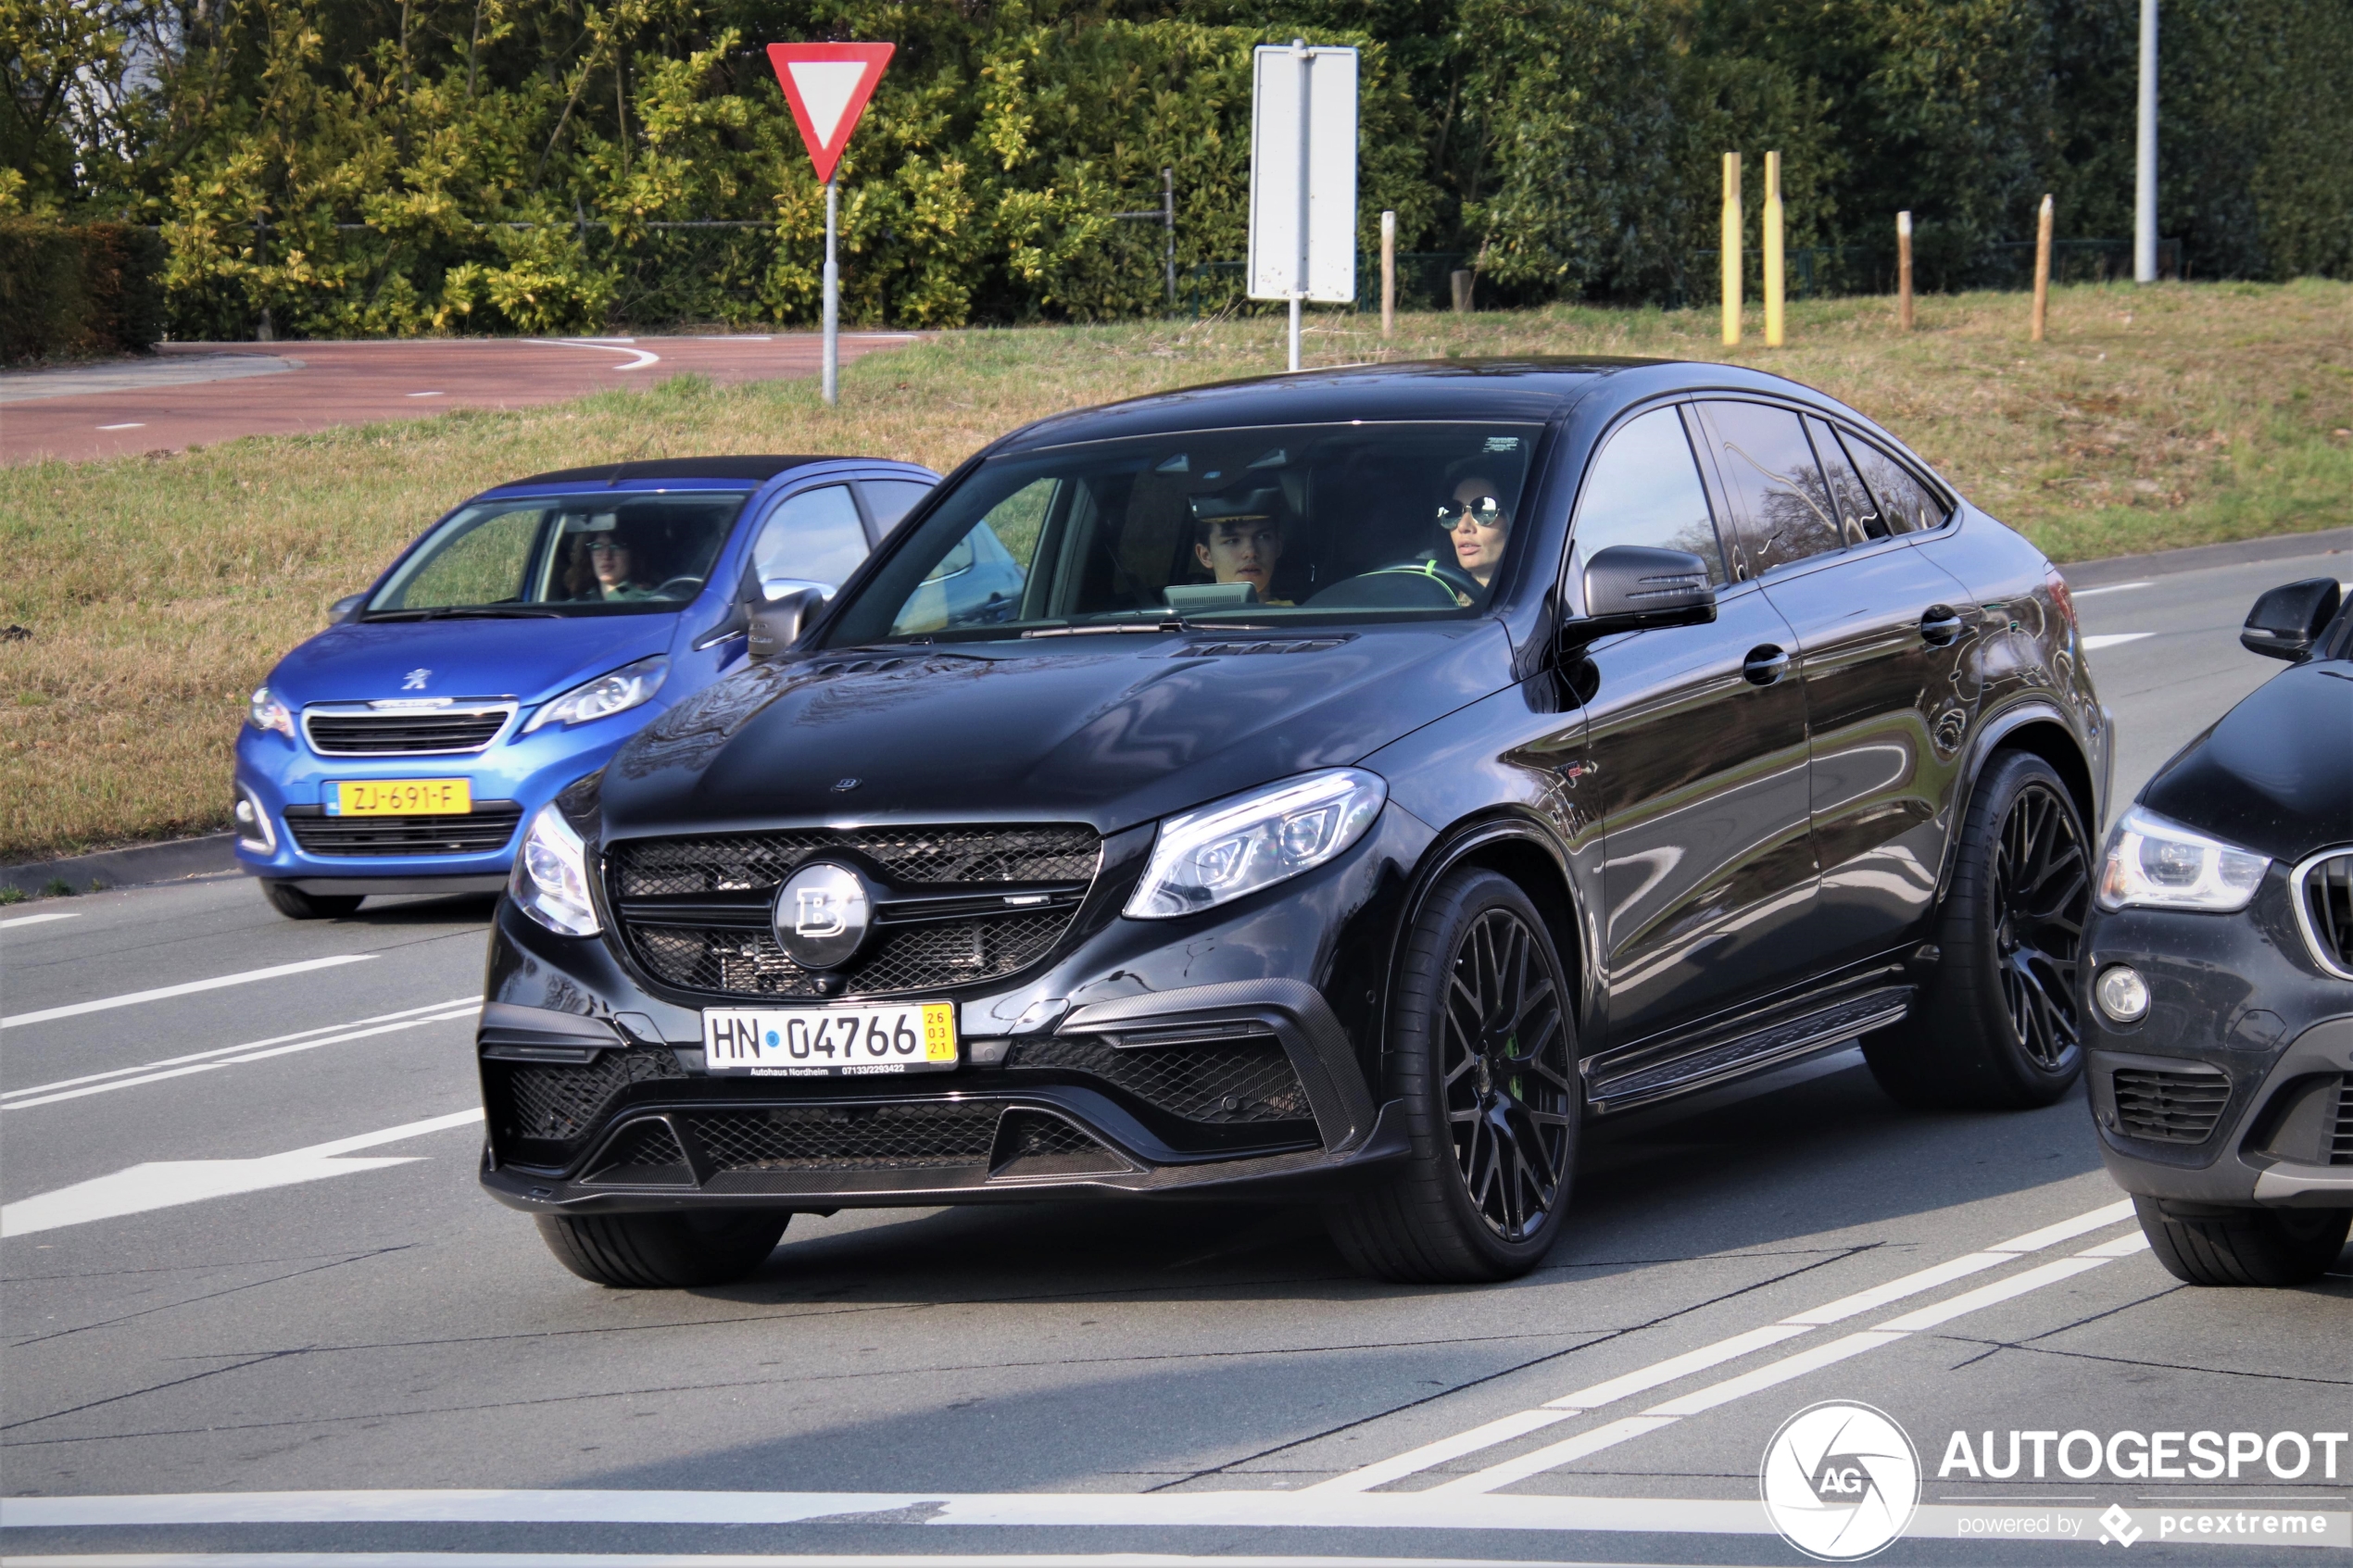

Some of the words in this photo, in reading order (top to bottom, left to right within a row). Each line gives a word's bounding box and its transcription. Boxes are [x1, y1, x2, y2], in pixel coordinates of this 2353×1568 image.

[354, 785, 452, 810] ZJ-691-F
[796, 887, 847, 938] B
[1436, 923, 1460, 1007] Continental
[926, 1012, 944, 1024] 26
[712, 1018, 761, 1059] HN
[786, 1014, 917, 1059] 04766
[928, 1027, 946, 1039] 03
[929, 1042, 948, 1054] 21
[750, 1068, 787, 1076] Autohaus
[788, 1067, 829, 1076] Nordheim
[842, 1064, 905, 1075] 07133/2293422
